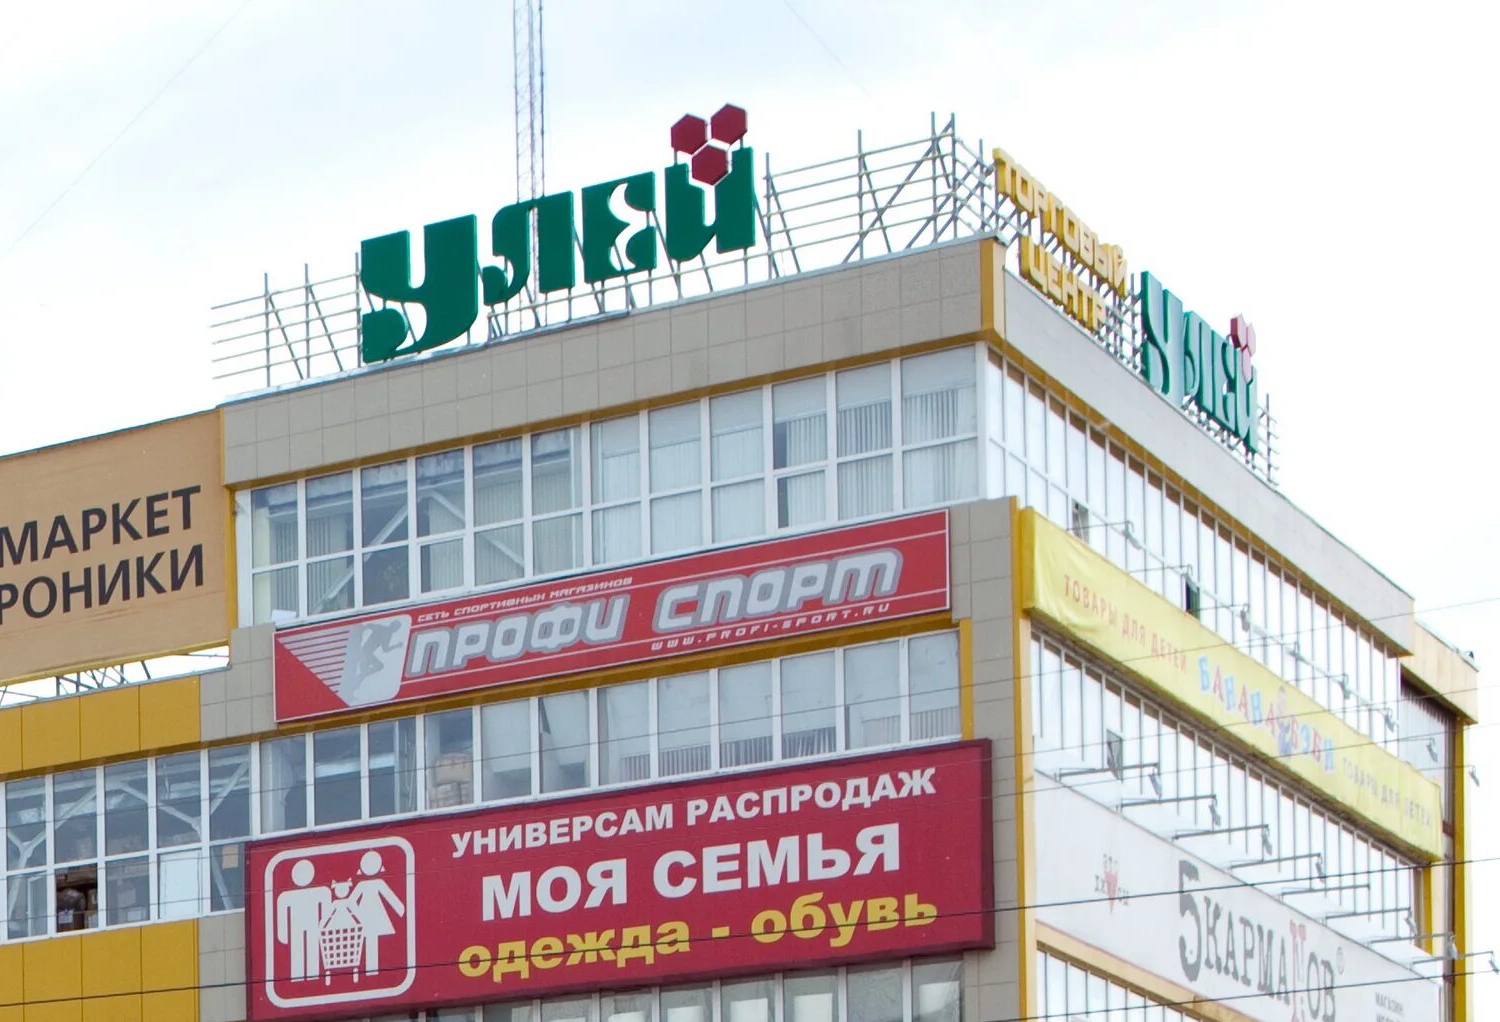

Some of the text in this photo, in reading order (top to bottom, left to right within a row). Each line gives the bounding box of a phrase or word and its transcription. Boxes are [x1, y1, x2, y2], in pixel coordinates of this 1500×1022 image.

[360, 103, 757, 364] УЛЕЙ
[993, 147, 1127, 297] ТОРГОВЫЙ
[1018, 235, 1107, 336] ЦЕНТР
[1141, 271, 1258, 453] УЛЕЙ
[406, 548, 904, 678] ПРОФИ СПОРТ
[418, 576, 633, 623] СЕТЬ СПОРТИВНЫХ МАГАЗИНОВ
[1063, 574, 1188, 674] ТОВАРЫ ДЛЯ ДЕТЕЙ
[451, 766, 937, 860] УНИВЕРСАМ РАСПРОДАЖ
[482, 822, 900, 922] МОЯ СЕМЬЯ
[457, 919, 690, 983] одежда
[751, 891, 939, 947] обувь
